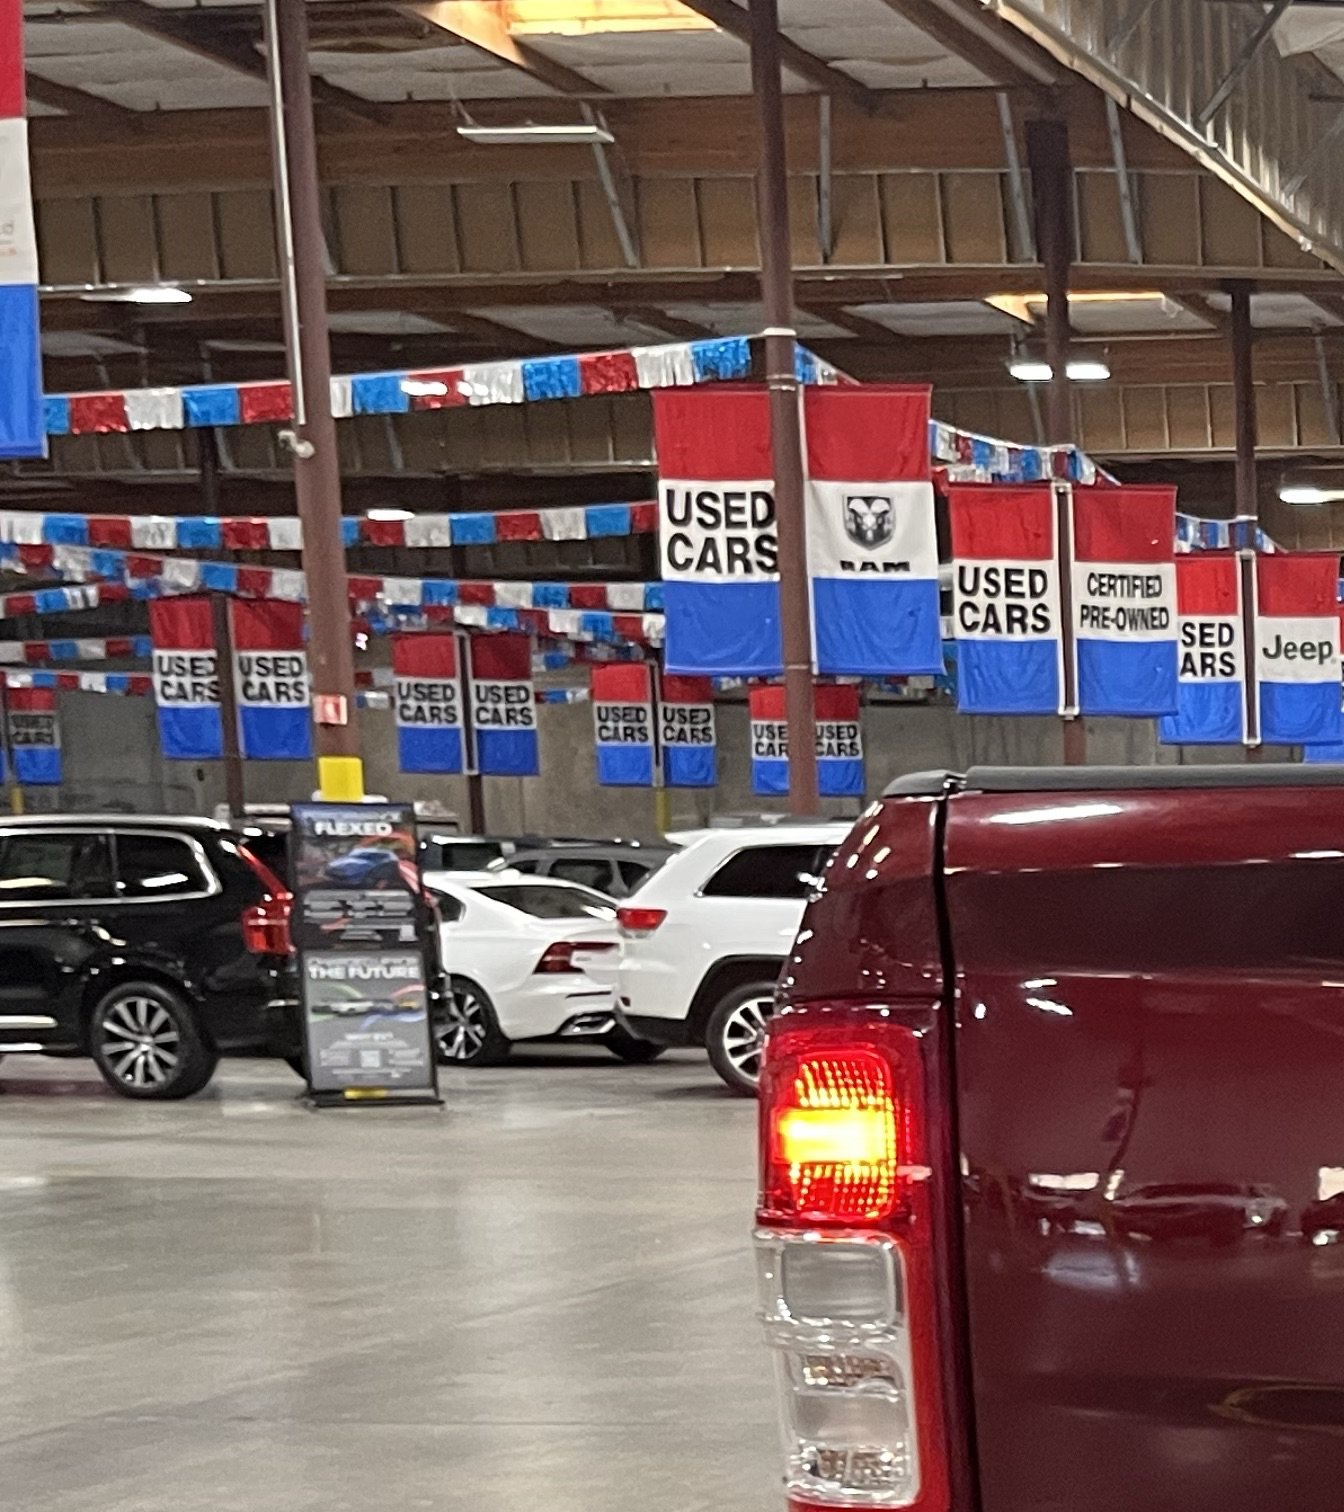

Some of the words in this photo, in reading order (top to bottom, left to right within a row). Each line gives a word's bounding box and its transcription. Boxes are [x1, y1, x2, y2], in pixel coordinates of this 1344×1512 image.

[666, 489, 776, 530] USED
[666, 532, 777, 574] CARS
[839, 559, 911, 572] RAM
[958, 565, 1048, 599] USED
[1086, 572, 1163, 598] CERTIFIED
[959, 601, 1051, 634] CARS
[1079, 603, 1170, 631] PRE-OWNED
[1181, 622, 1235, 648] SED
[1262, 634, 1333, 665] Jeep
[158, 655, 216, 677] USED
[238, 655, 304, 677] USED
[1179, 651, 1236, 677] ARS
[160, 680, 220, 702] CARS
[241, 681, 305, 702] CARS
[398, 682, 456, 702] USED
[475, 682, 530, 704] USED
[399, 704, 458, 724] CARS
[475, 706, 533, 725] CARS
[597, 705, 648, 723] USED
[662, 706, 711, 724] USED
[599, 724, 649, 742] CARS
[662, 726, 713, 743] CARS
[753, 724, 788, 739] USE
[754, 742, 789, 757] CAR
[309, 965, 345, 979] THE
[348, 965, 419, 979] FUTURE
